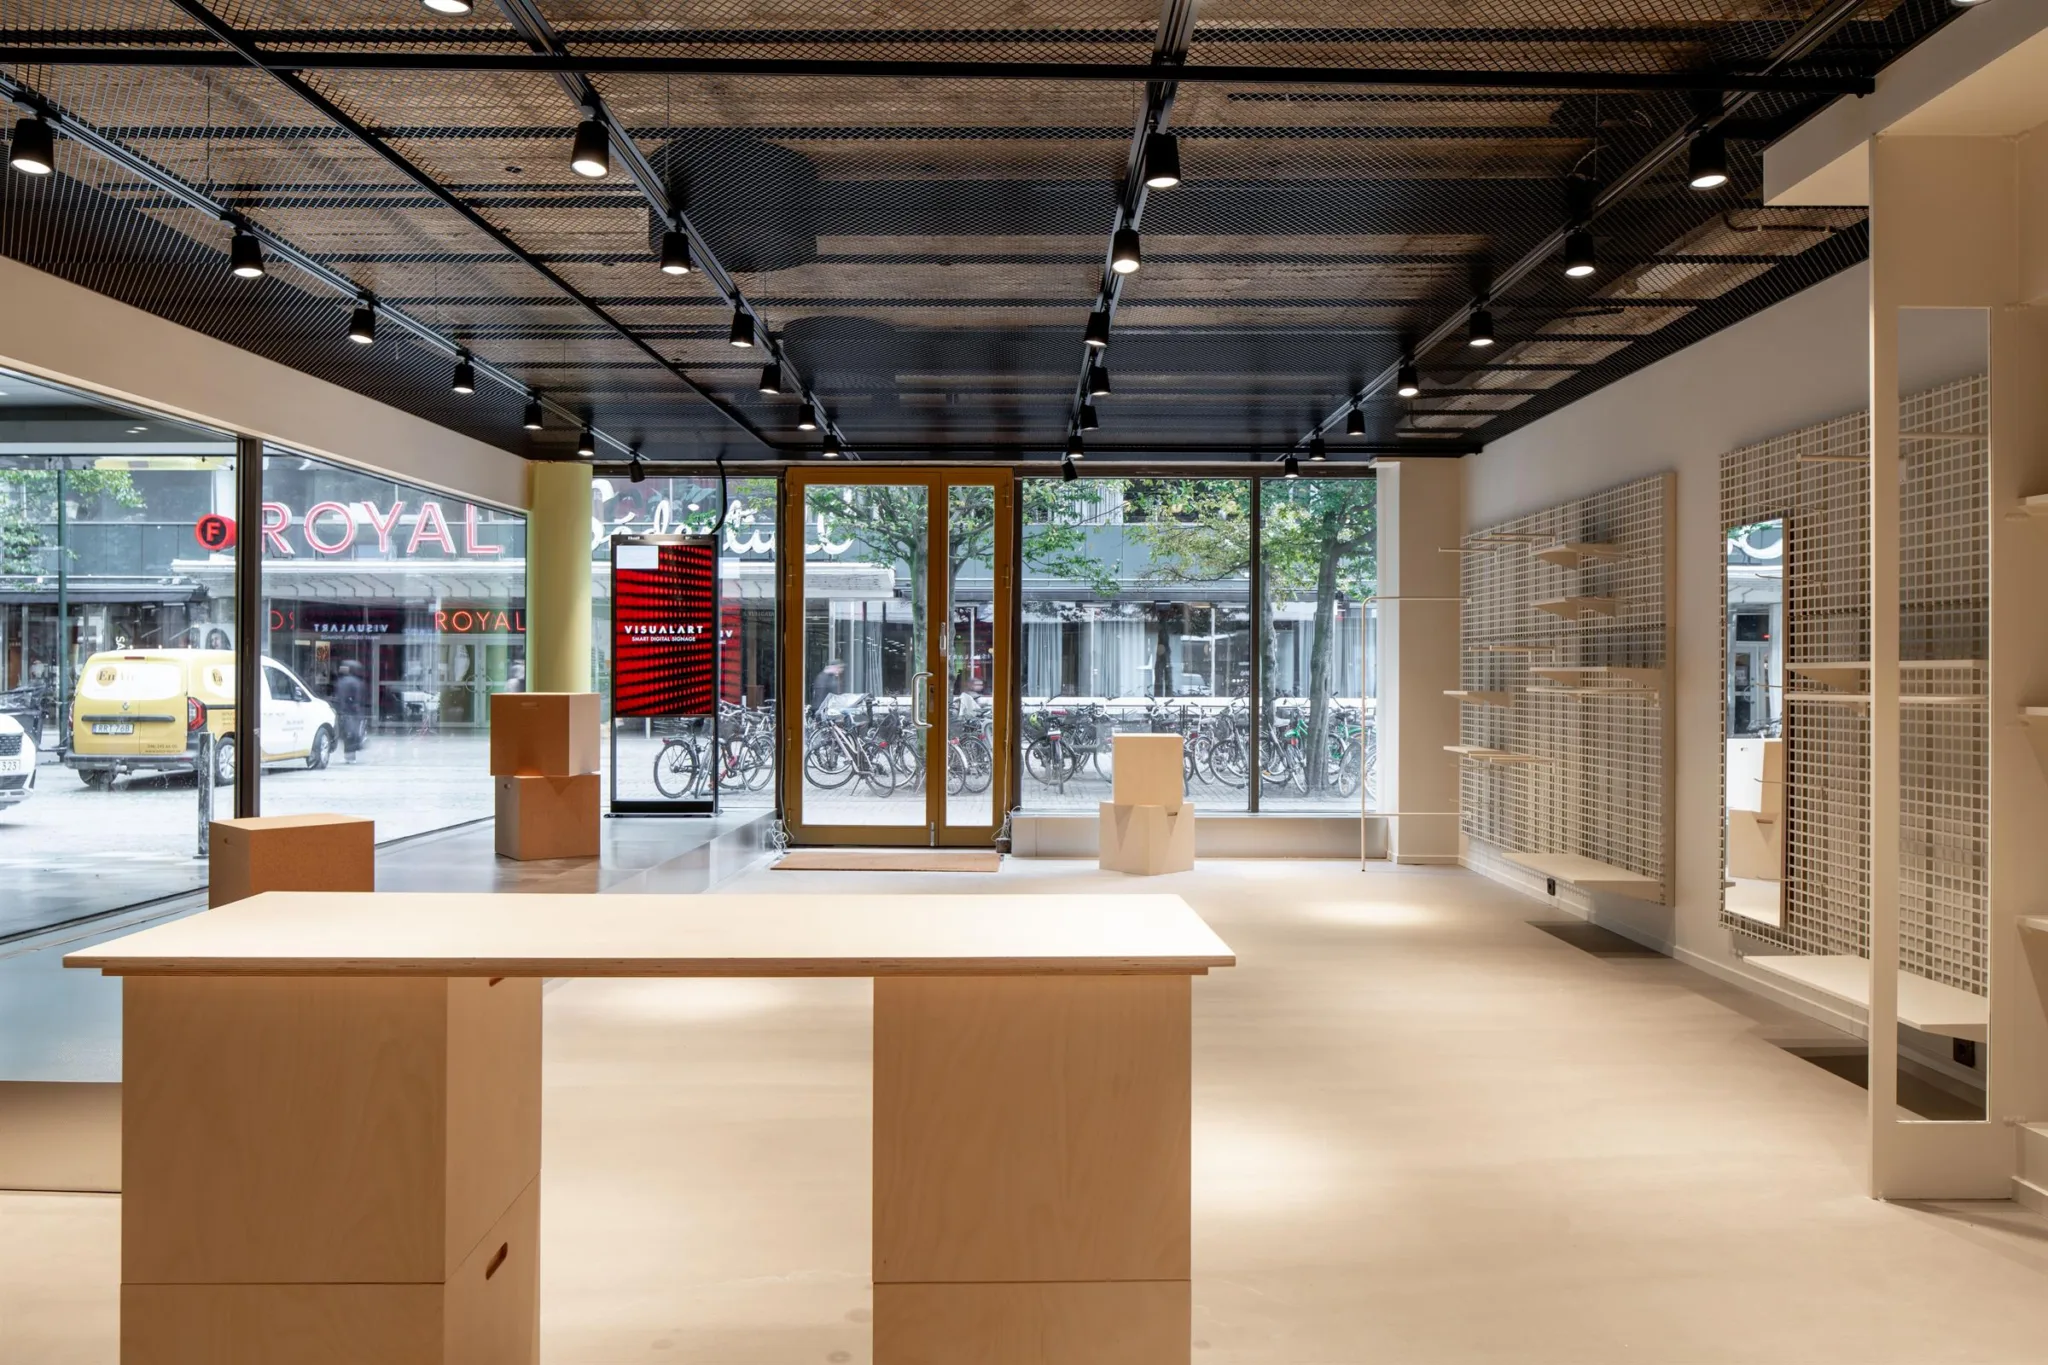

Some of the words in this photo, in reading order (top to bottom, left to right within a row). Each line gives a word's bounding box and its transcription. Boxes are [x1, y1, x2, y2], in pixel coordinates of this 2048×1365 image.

[206, 522, 221, 541] F
[262, 501, 504, 554] ROYAL
[434, 611, 526, 631] ROYAL
[624, 625, 704, 635] VISUALART
